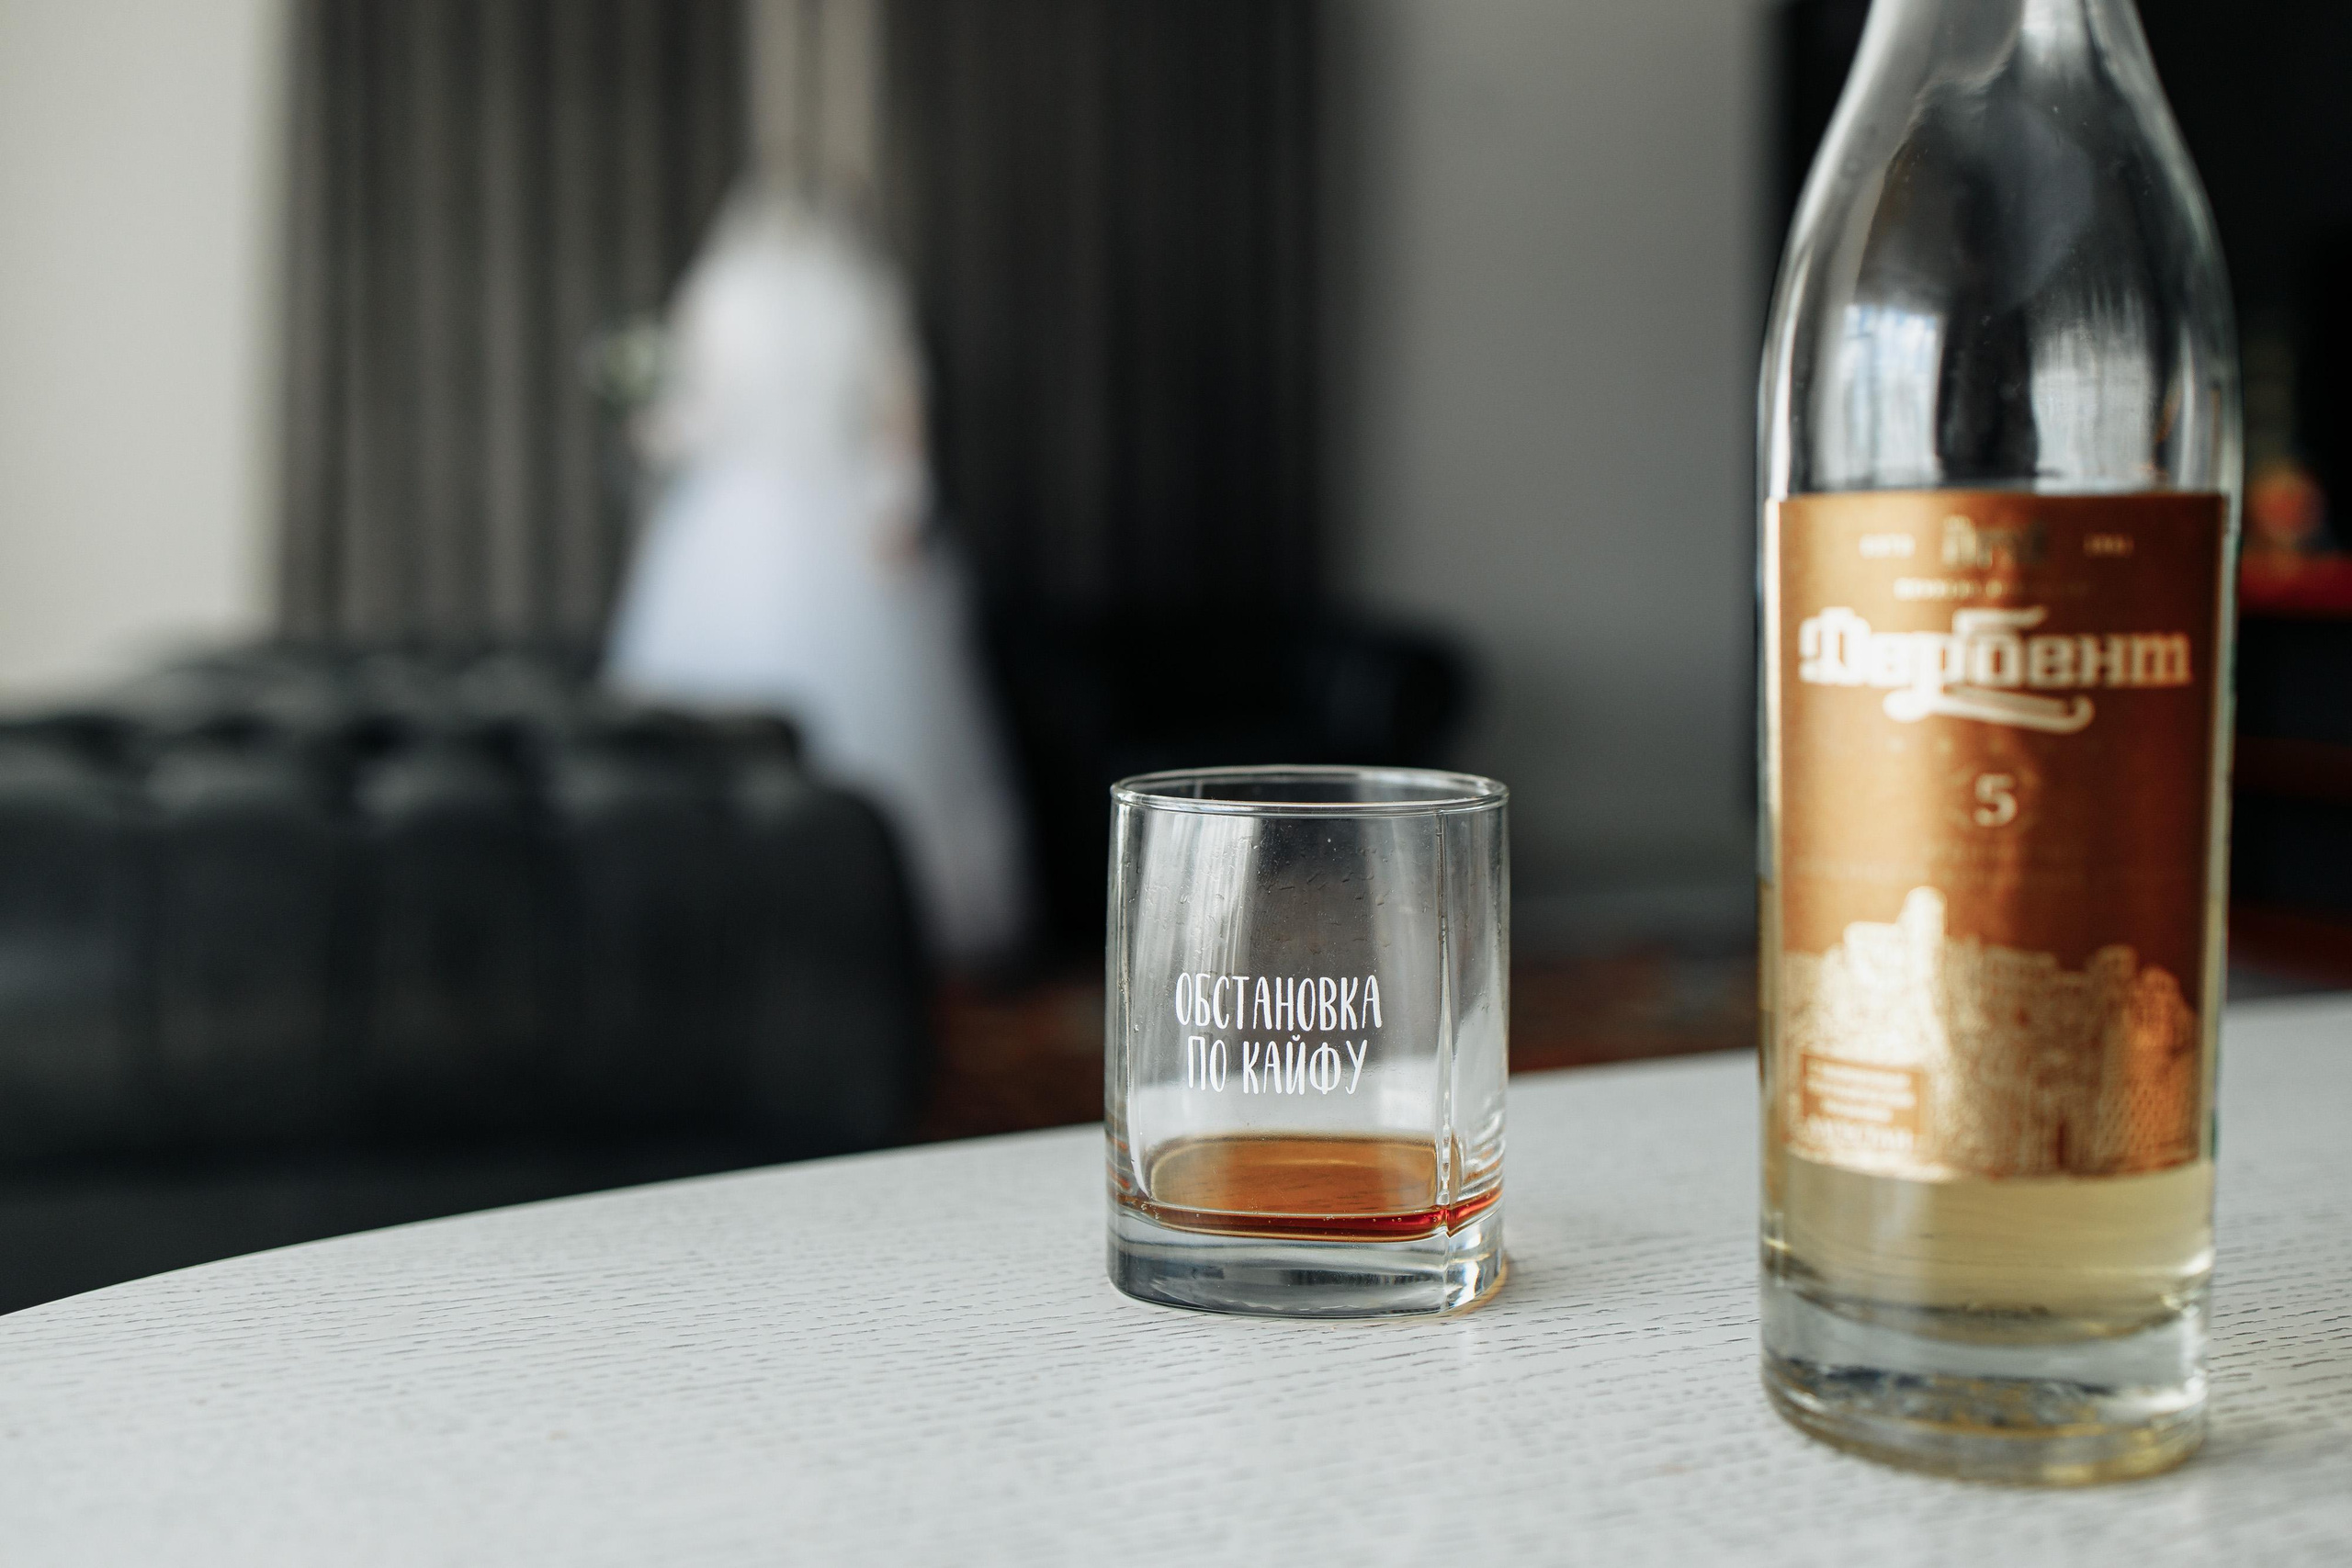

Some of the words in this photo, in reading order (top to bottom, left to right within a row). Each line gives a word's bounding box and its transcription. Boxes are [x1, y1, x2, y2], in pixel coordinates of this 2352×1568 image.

[1799, 606, 2193, 734] Дербент
[1973, 773, 2018, 827] 5
[1176, 973, 1382, 1031] ОБСТАНОВКА
[1188, 1036, 1227, 1092] ПО
[1243, 1034, 1367, 1095] КАЙФУ
